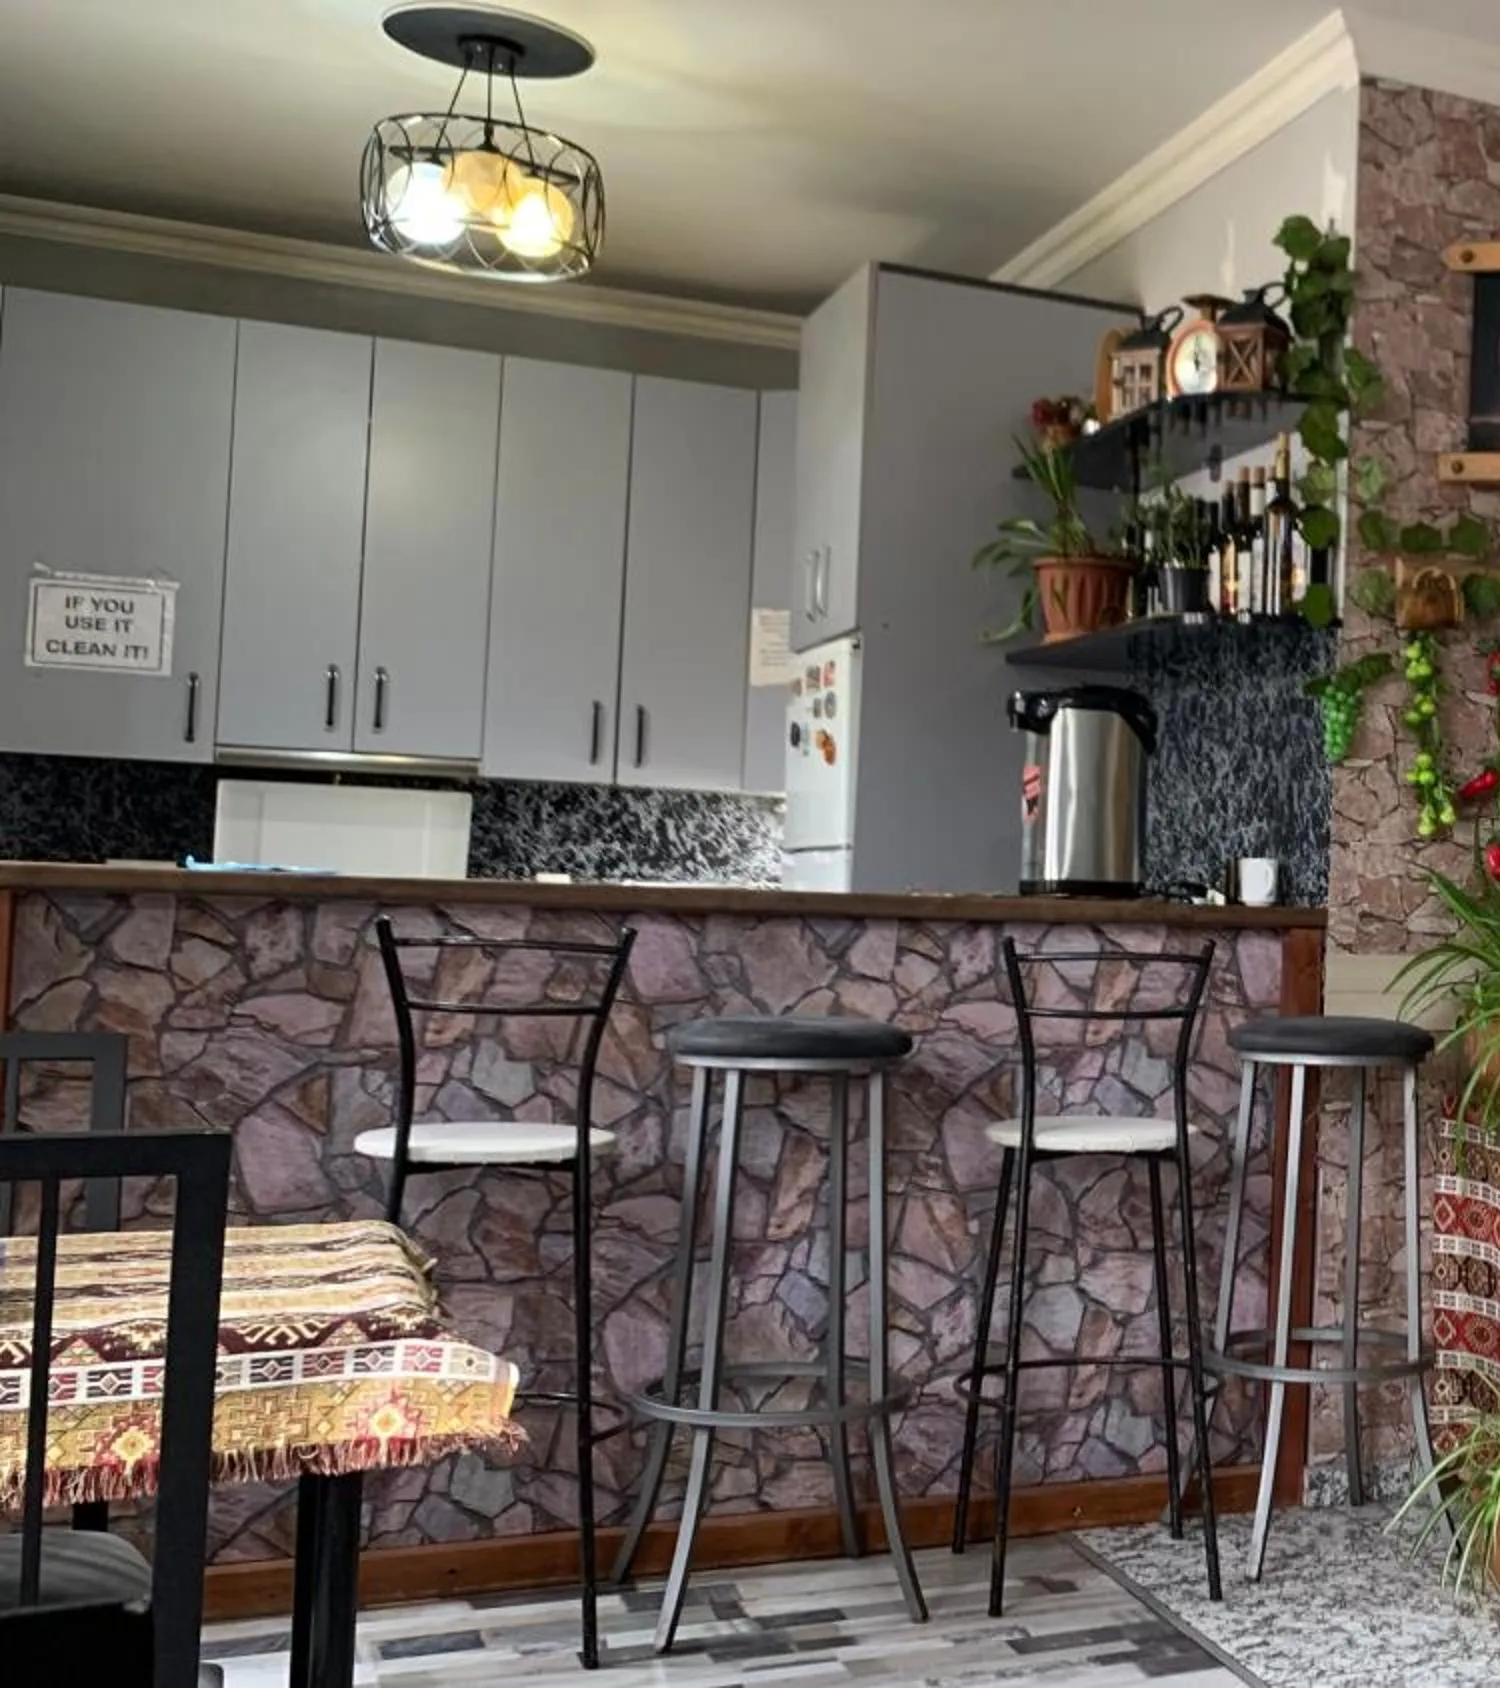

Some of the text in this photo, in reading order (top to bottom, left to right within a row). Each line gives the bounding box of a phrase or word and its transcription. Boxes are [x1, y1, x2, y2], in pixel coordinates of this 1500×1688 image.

[65, 595, 134, 615] IF YOU
[65, 615, 134, 633] USE IT
[46, 639, 149, 660] CLEAN IT!
